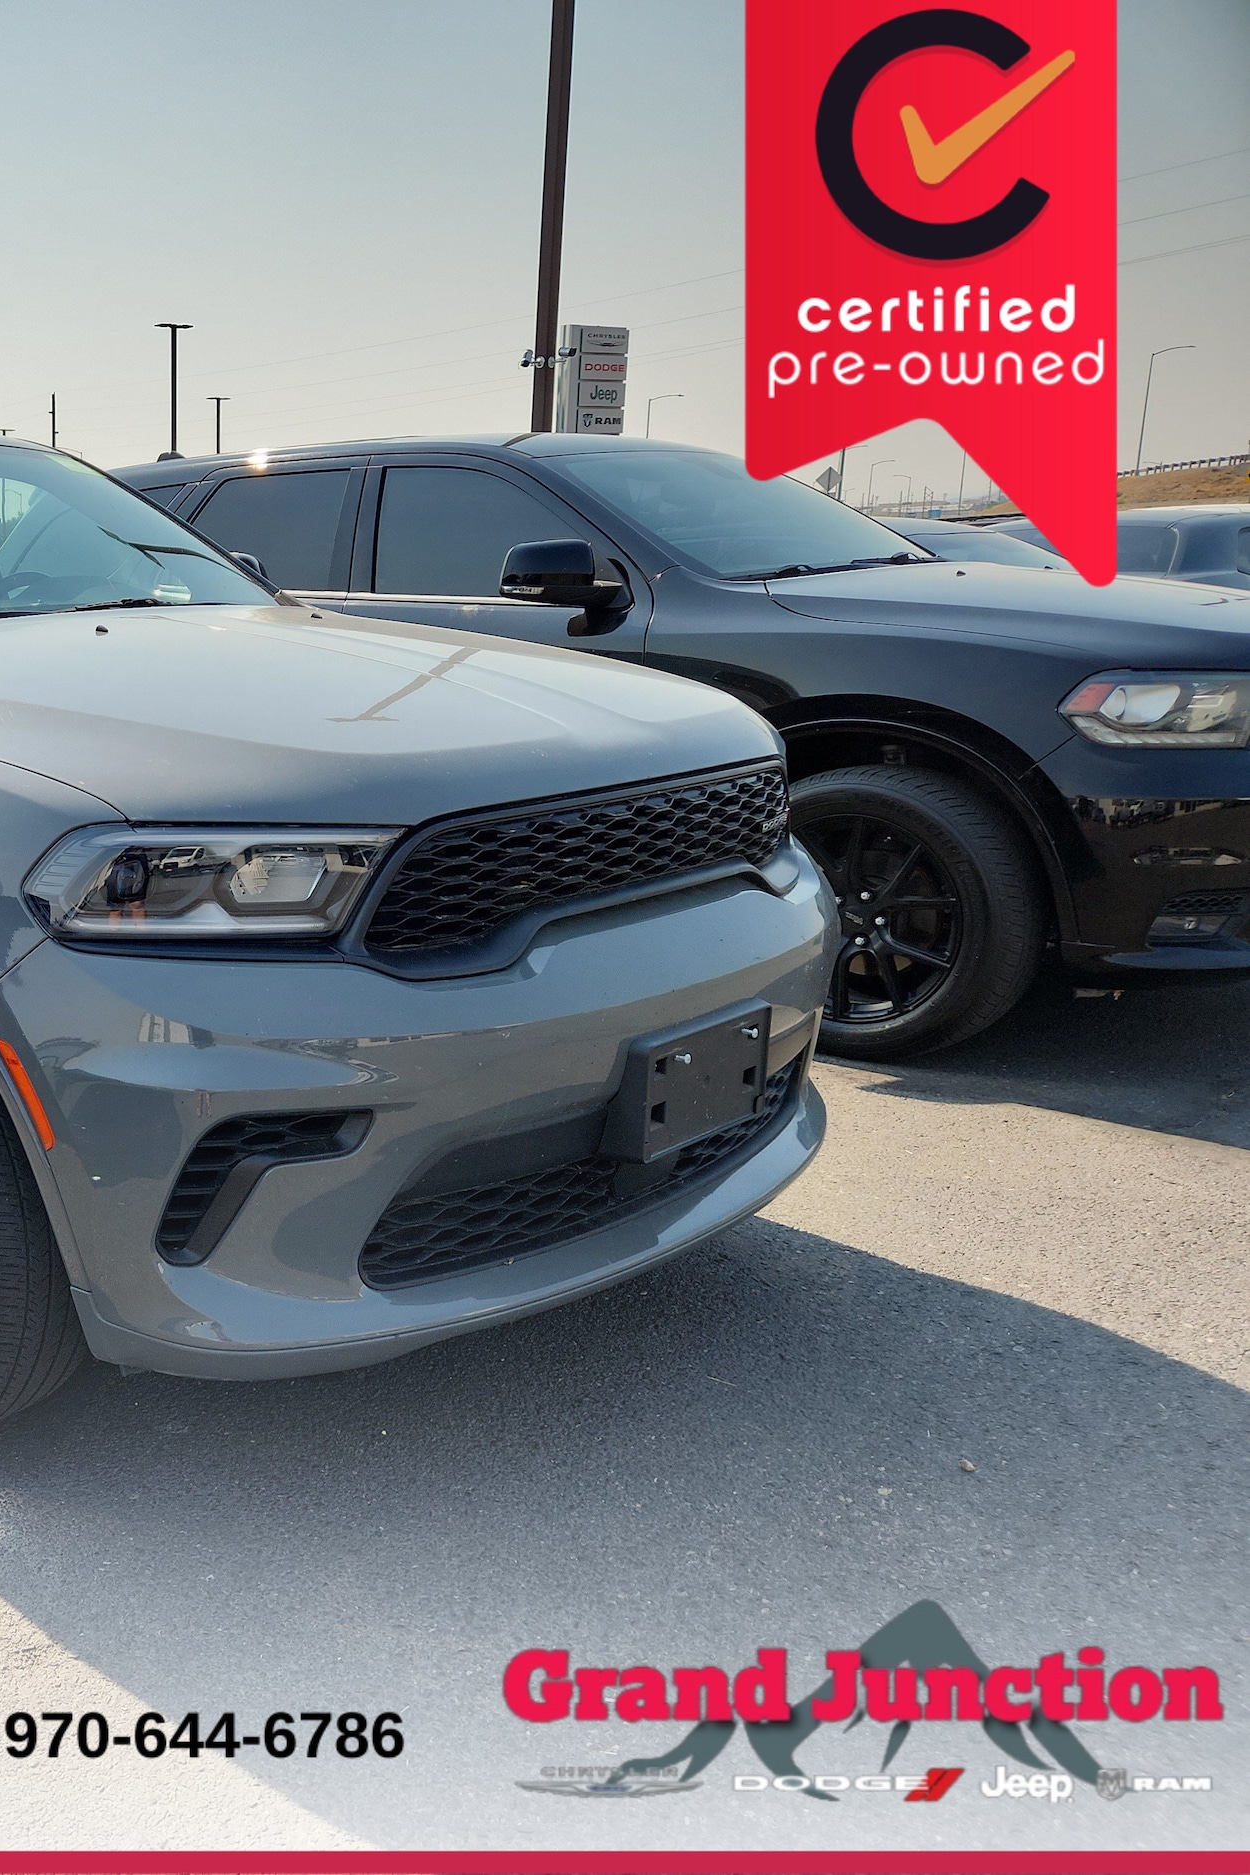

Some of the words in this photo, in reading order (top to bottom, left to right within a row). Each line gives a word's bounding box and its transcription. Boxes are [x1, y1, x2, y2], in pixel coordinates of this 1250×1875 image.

[584, 363, 625, 372] DODGE
[590, 385, 618, 404] Jeep
[594, 417, 621, 425] RAM
